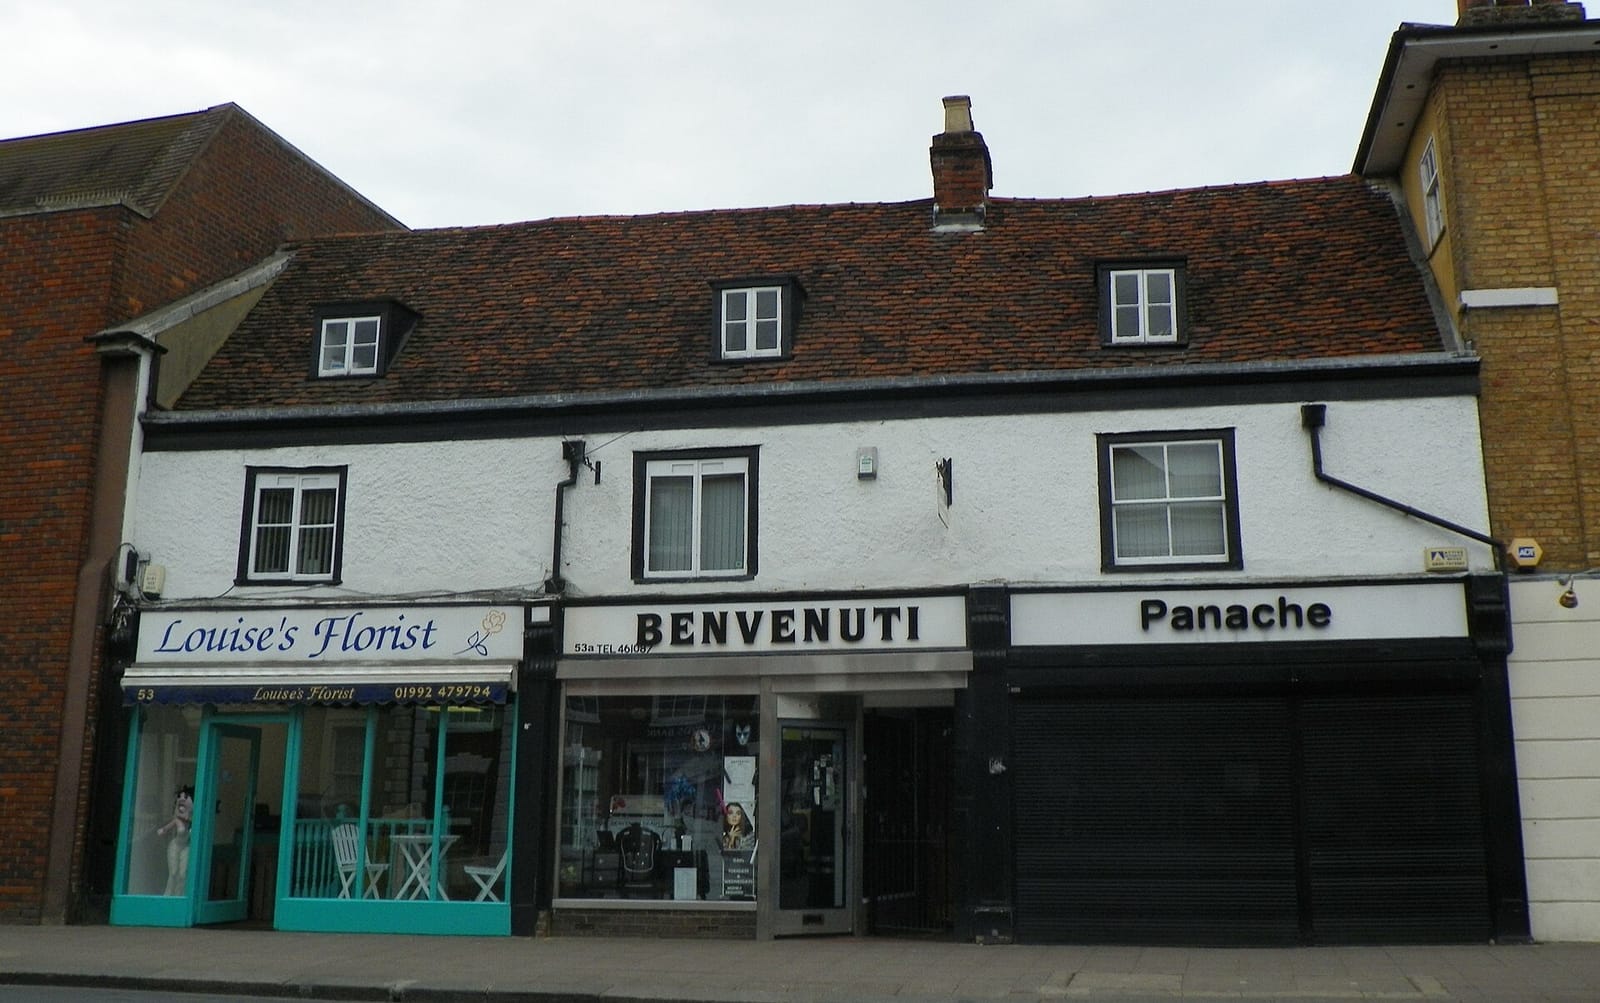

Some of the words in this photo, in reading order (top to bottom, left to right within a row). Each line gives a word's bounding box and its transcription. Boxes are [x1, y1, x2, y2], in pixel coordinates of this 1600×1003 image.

[635, 605, 920, 647] BENVENUTI
[1140, 595, 1333, 632] Panache
[153, 615, 299, 653] Louise's
[308, 612, 438, 658] Florist
[574, 643, 594, 653] 53a
[137, 689, 155, 701] 53
[252, 686, 304, 702] Louise's
[306, 686, 355, 702] Florist
[394, 686, 433, 699] 01992
[438, 685, 491, 698] 479794
